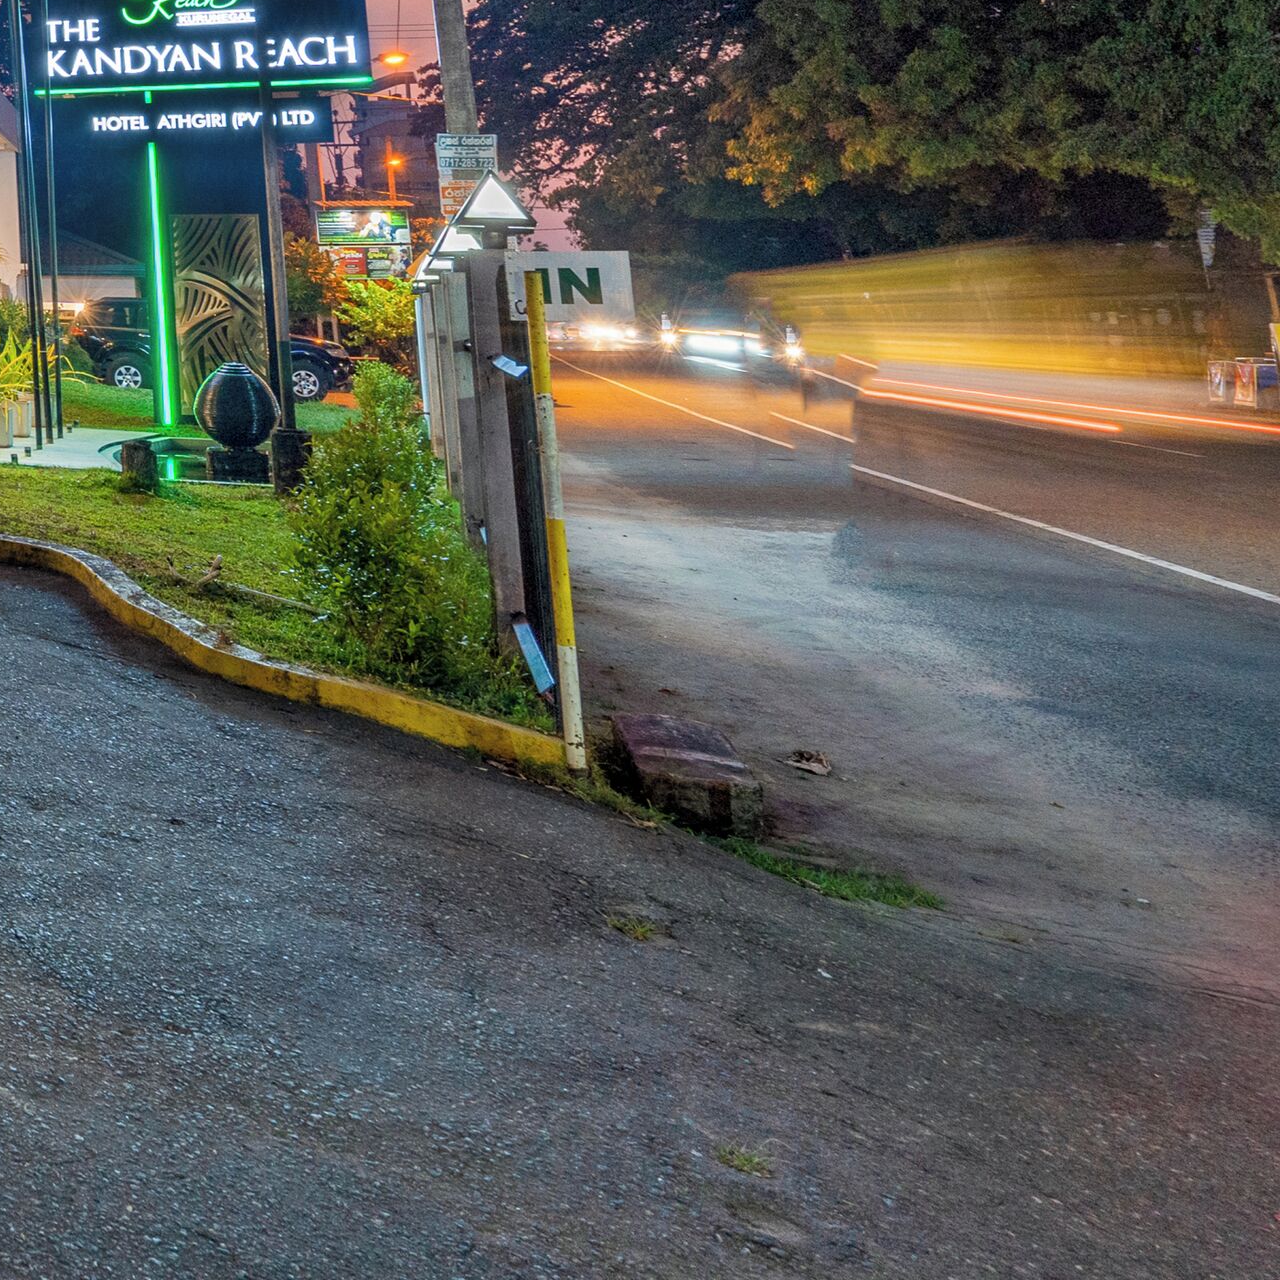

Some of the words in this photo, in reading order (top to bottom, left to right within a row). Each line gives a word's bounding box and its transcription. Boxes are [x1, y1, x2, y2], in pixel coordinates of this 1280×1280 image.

[46, 19, 100, 43] THE
[47, 42, 221, 77] KANDYAN
[234, 35, 357, 69] REACH
[93, 116, 149, 131] HOTEL
[157, 113, 227, 129] ATHGIRI
[282, 110, 315, 126] LTD
[535, 267, 603, 304] IN
